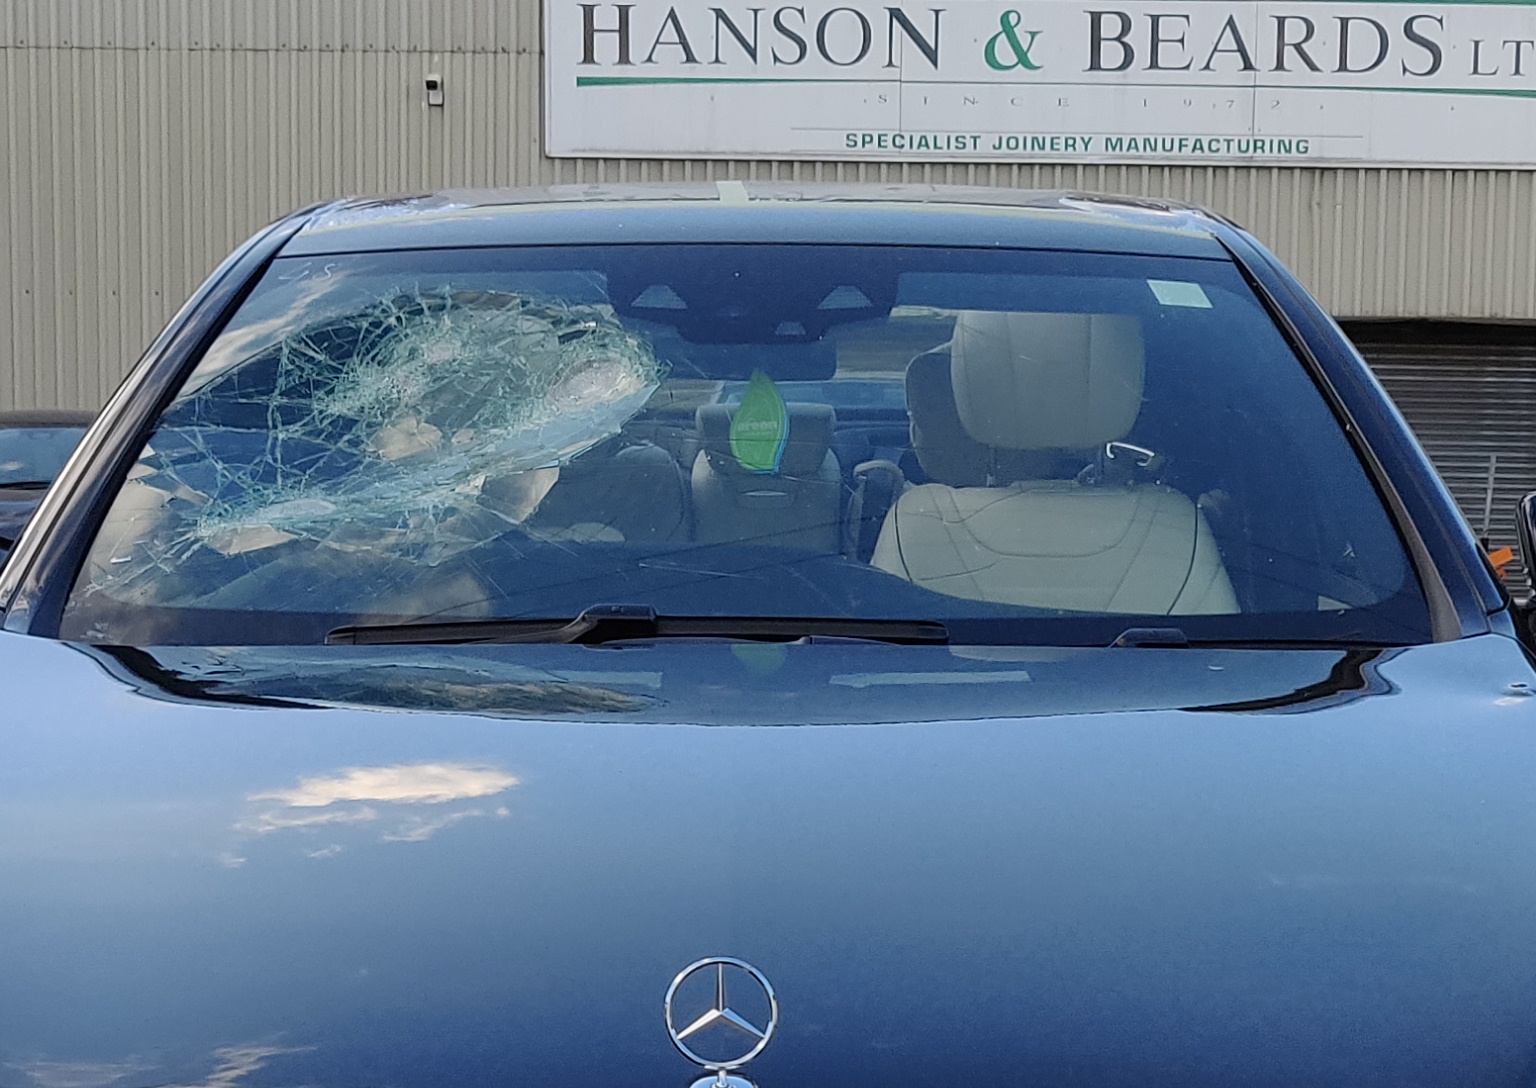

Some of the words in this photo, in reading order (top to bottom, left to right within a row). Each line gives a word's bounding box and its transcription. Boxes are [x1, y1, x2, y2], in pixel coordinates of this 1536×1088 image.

[576, 4, 946, 70] HANSON
[983, 10, 1044, 72] &
[1081, 10, 1445, 77] BEARDS
[845, 132, 982, 151] SPECIALIST
[992, 134, 1094, 152] JOINERY
[1103, 136, 1310, 155] MANUFACTURING
